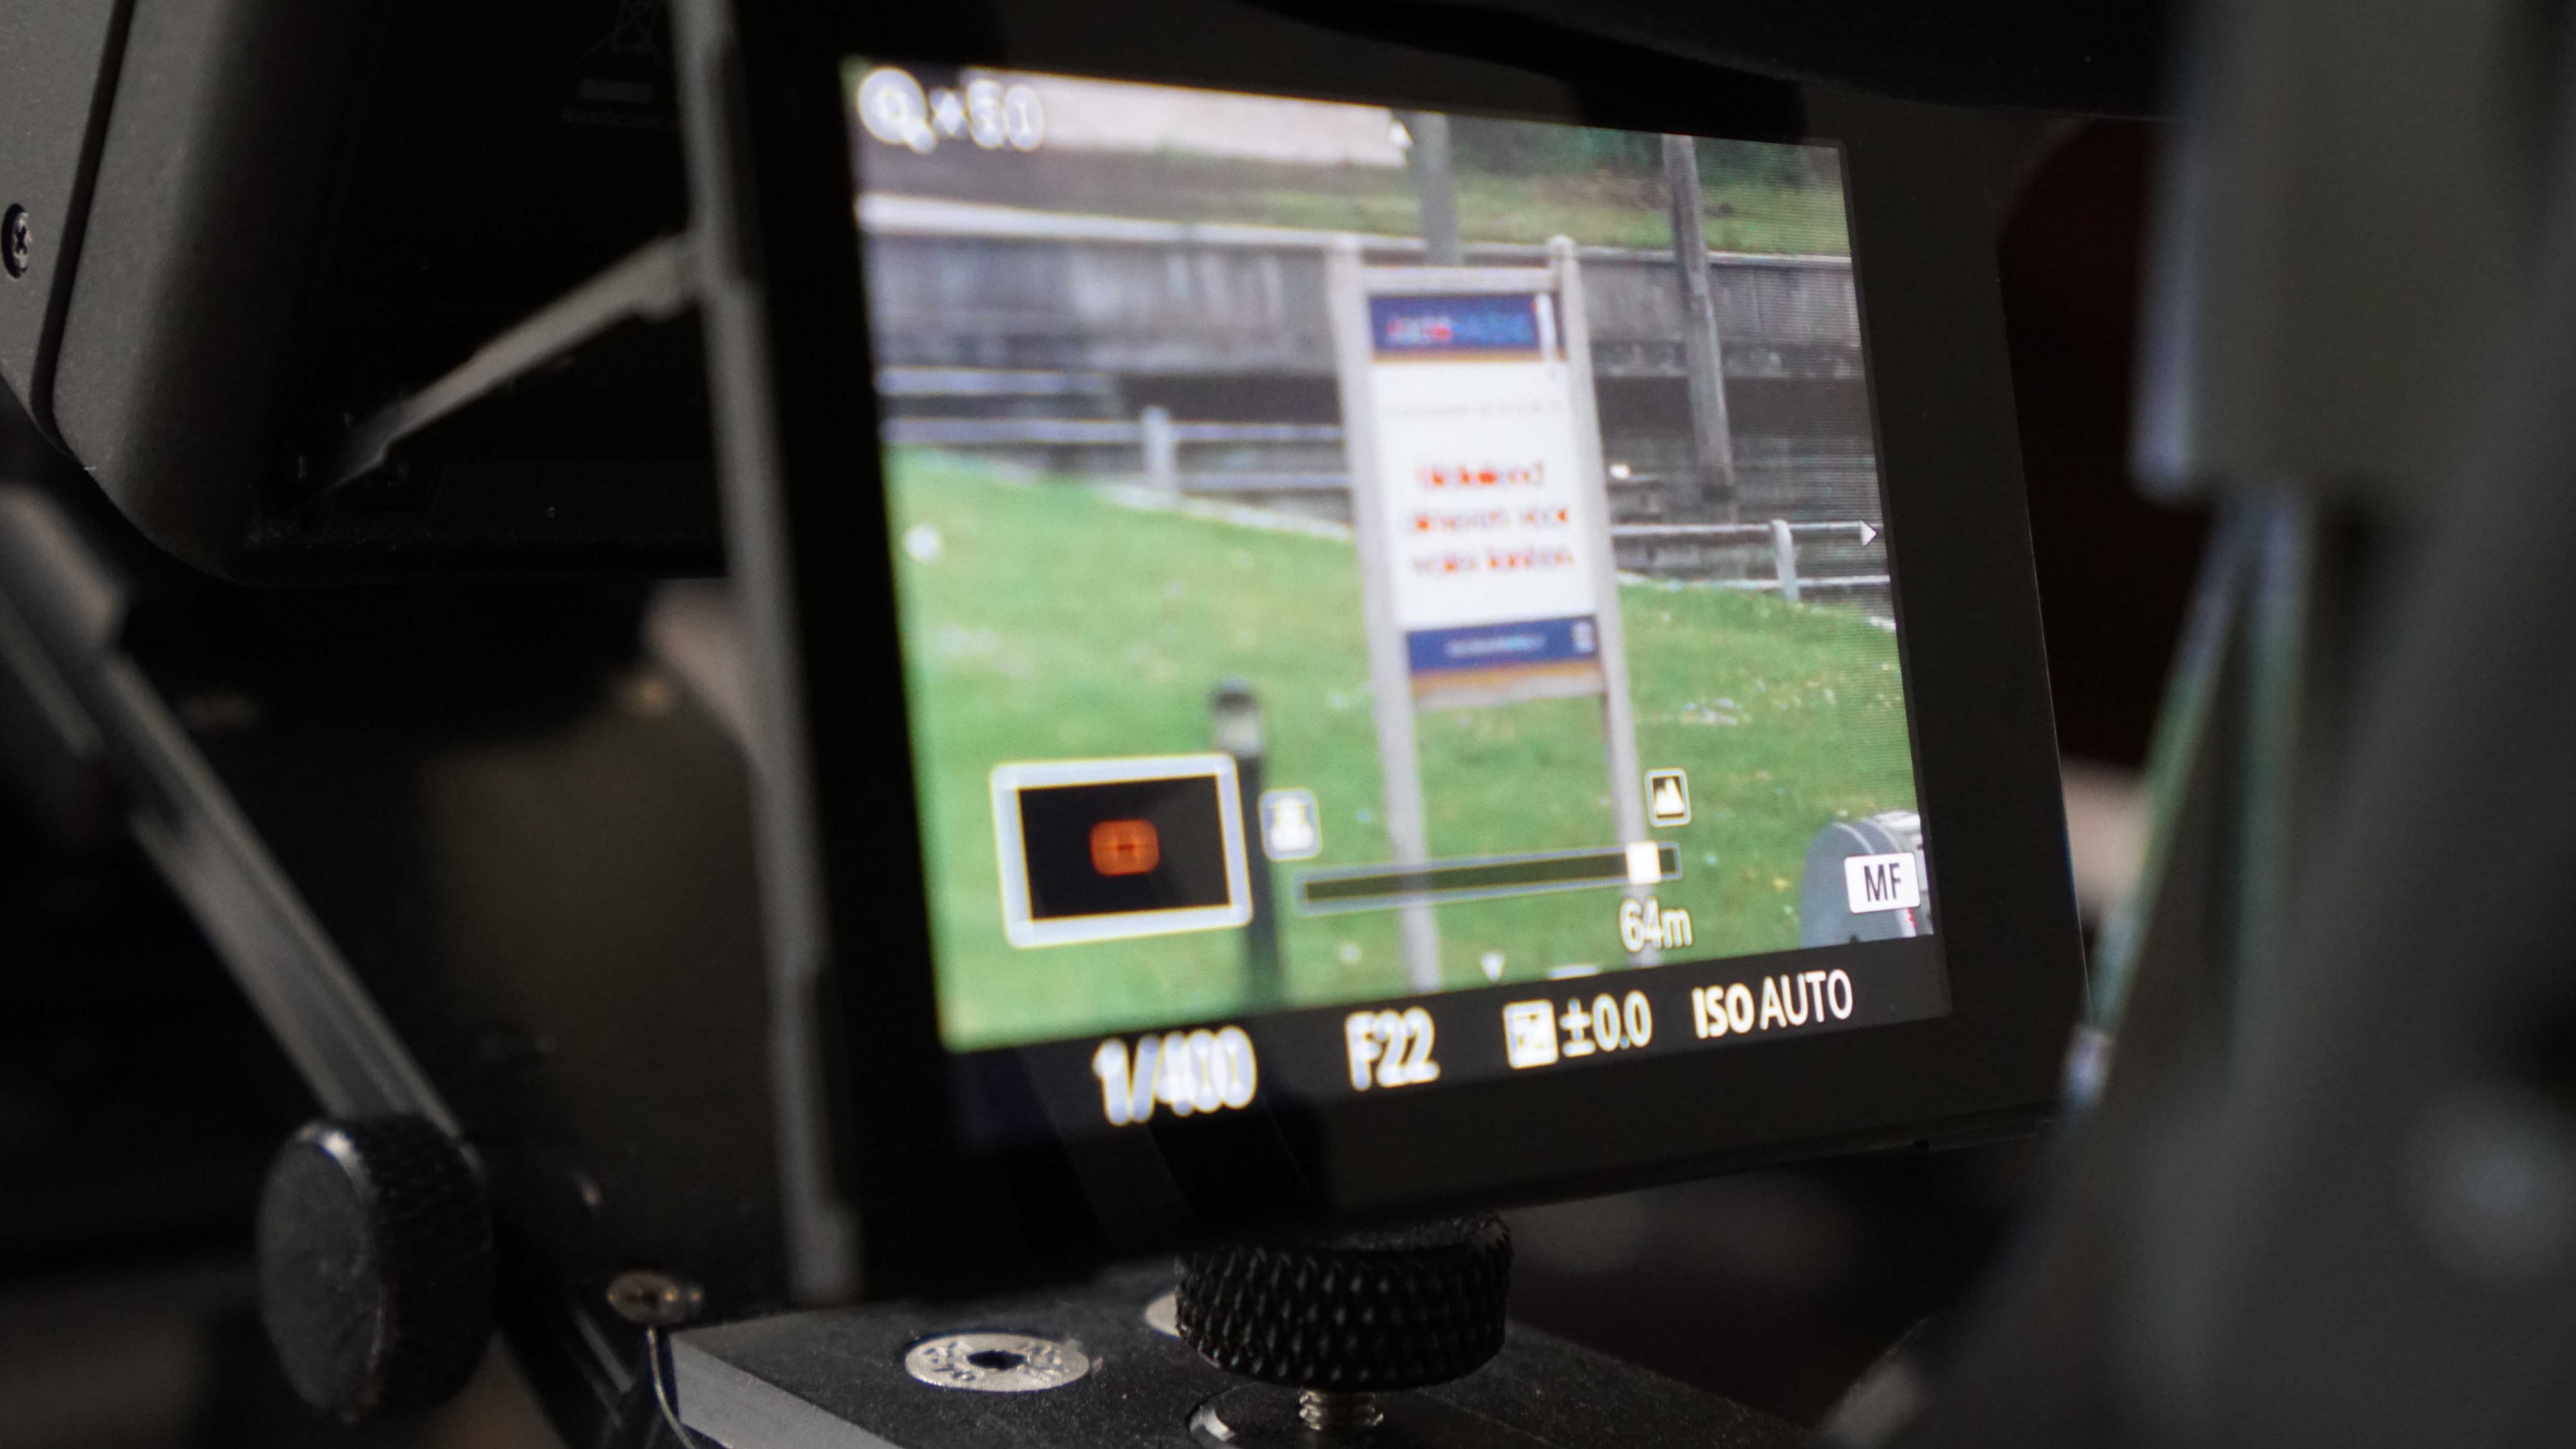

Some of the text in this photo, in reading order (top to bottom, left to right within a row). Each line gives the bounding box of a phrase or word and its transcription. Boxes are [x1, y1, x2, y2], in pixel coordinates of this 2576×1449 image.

[1863, 862, 1902, 903] MF
[1620, 896, 1693, 952] 64m
[1092, 969, 1853, 1125] 1/400 F22 ±0.0 ISO AUTO
